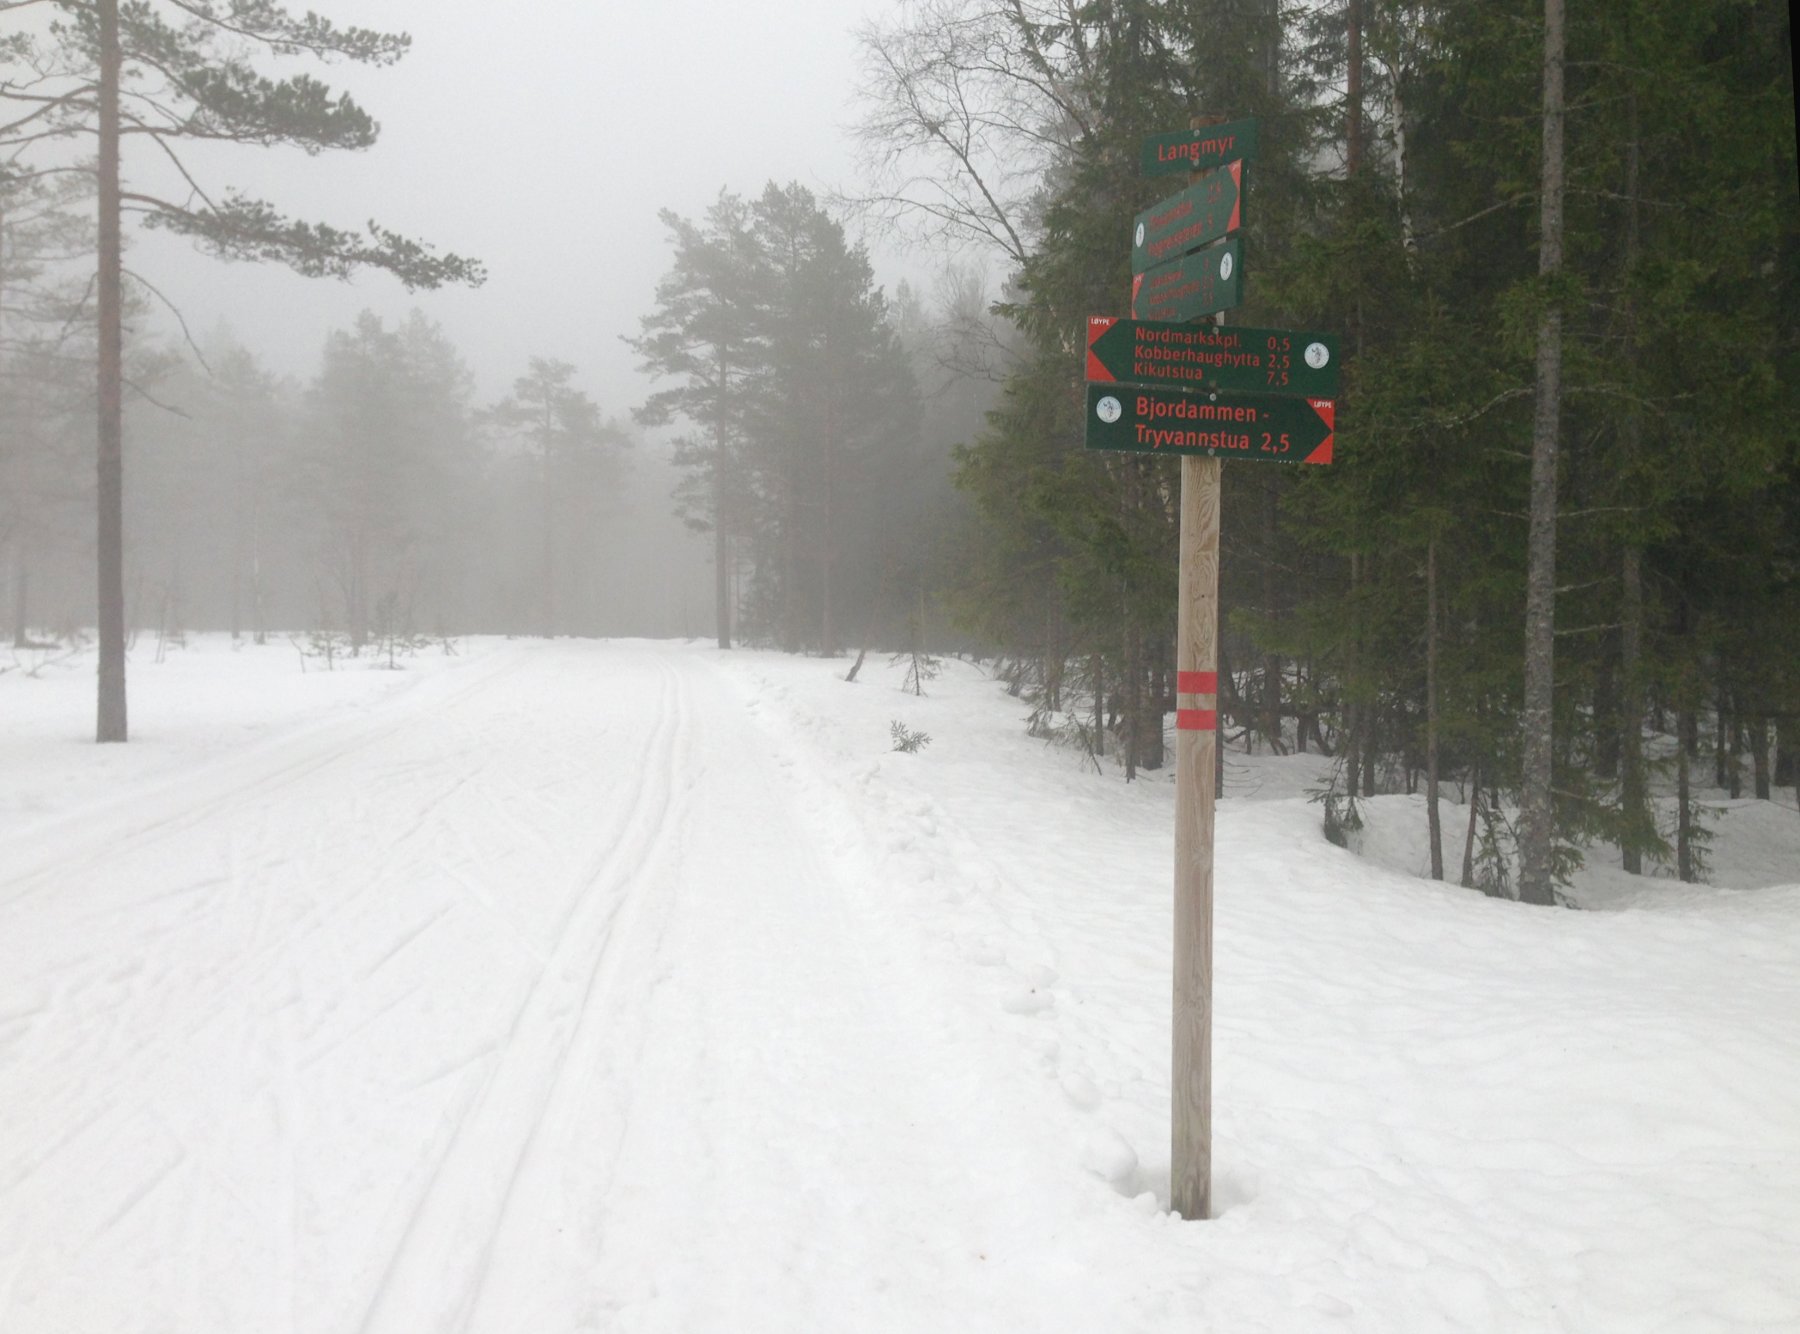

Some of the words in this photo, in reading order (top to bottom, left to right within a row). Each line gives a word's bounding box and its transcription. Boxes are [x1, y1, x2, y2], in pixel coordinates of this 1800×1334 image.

[1158, 135, 1236, 161] Langmyr
[1135, 345, 1260, 369] Kobberhaughytta
[1134, 362, 1203, 380] Kikutstua
[1136, 396, 1256, 422] Bjordammen
[1135, 424, 1250, 449] Tryvannstua
[1260, 432, 1290, 454] 2,5
